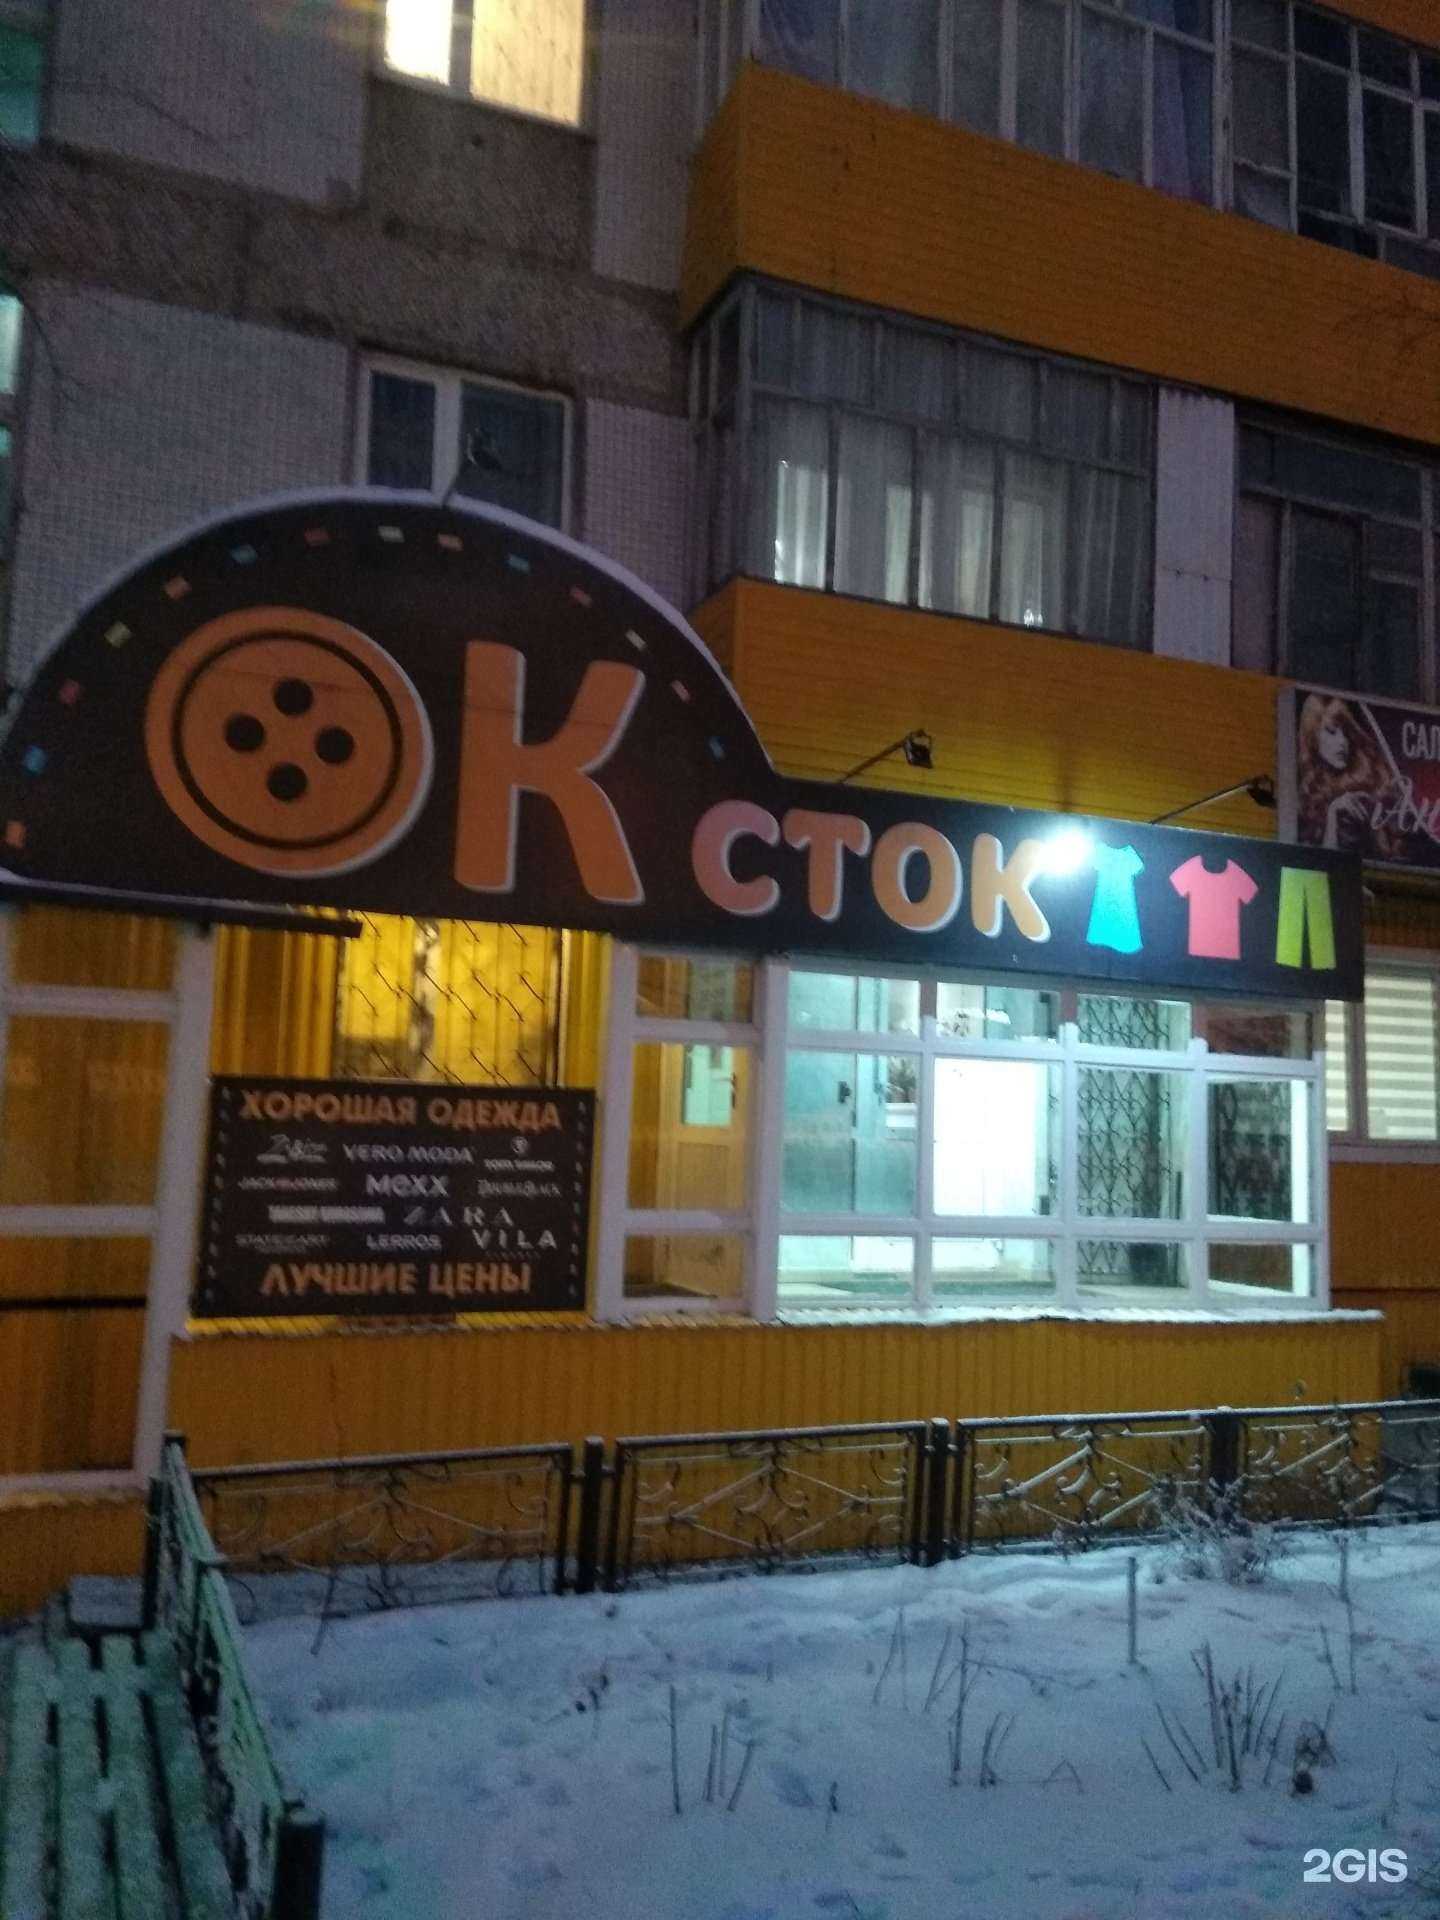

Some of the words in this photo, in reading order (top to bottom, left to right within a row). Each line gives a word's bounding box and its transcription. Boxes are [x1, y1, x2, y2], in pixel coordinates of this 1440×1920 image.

[239, 1089, 417, 1126] ХОРОШАЯ
[426, 1098, 562, 1133] ОДЕЖДА
[343, 1143, 401, 1162] VERO
[407, 1145, 474, 1163] MODA
[472, 1228, 558, 1250] VILA
[260, 1261, 418, 1297] ЛУЧШИЕ
[428, 1262, 532, 1298] ЦЕНЫ
